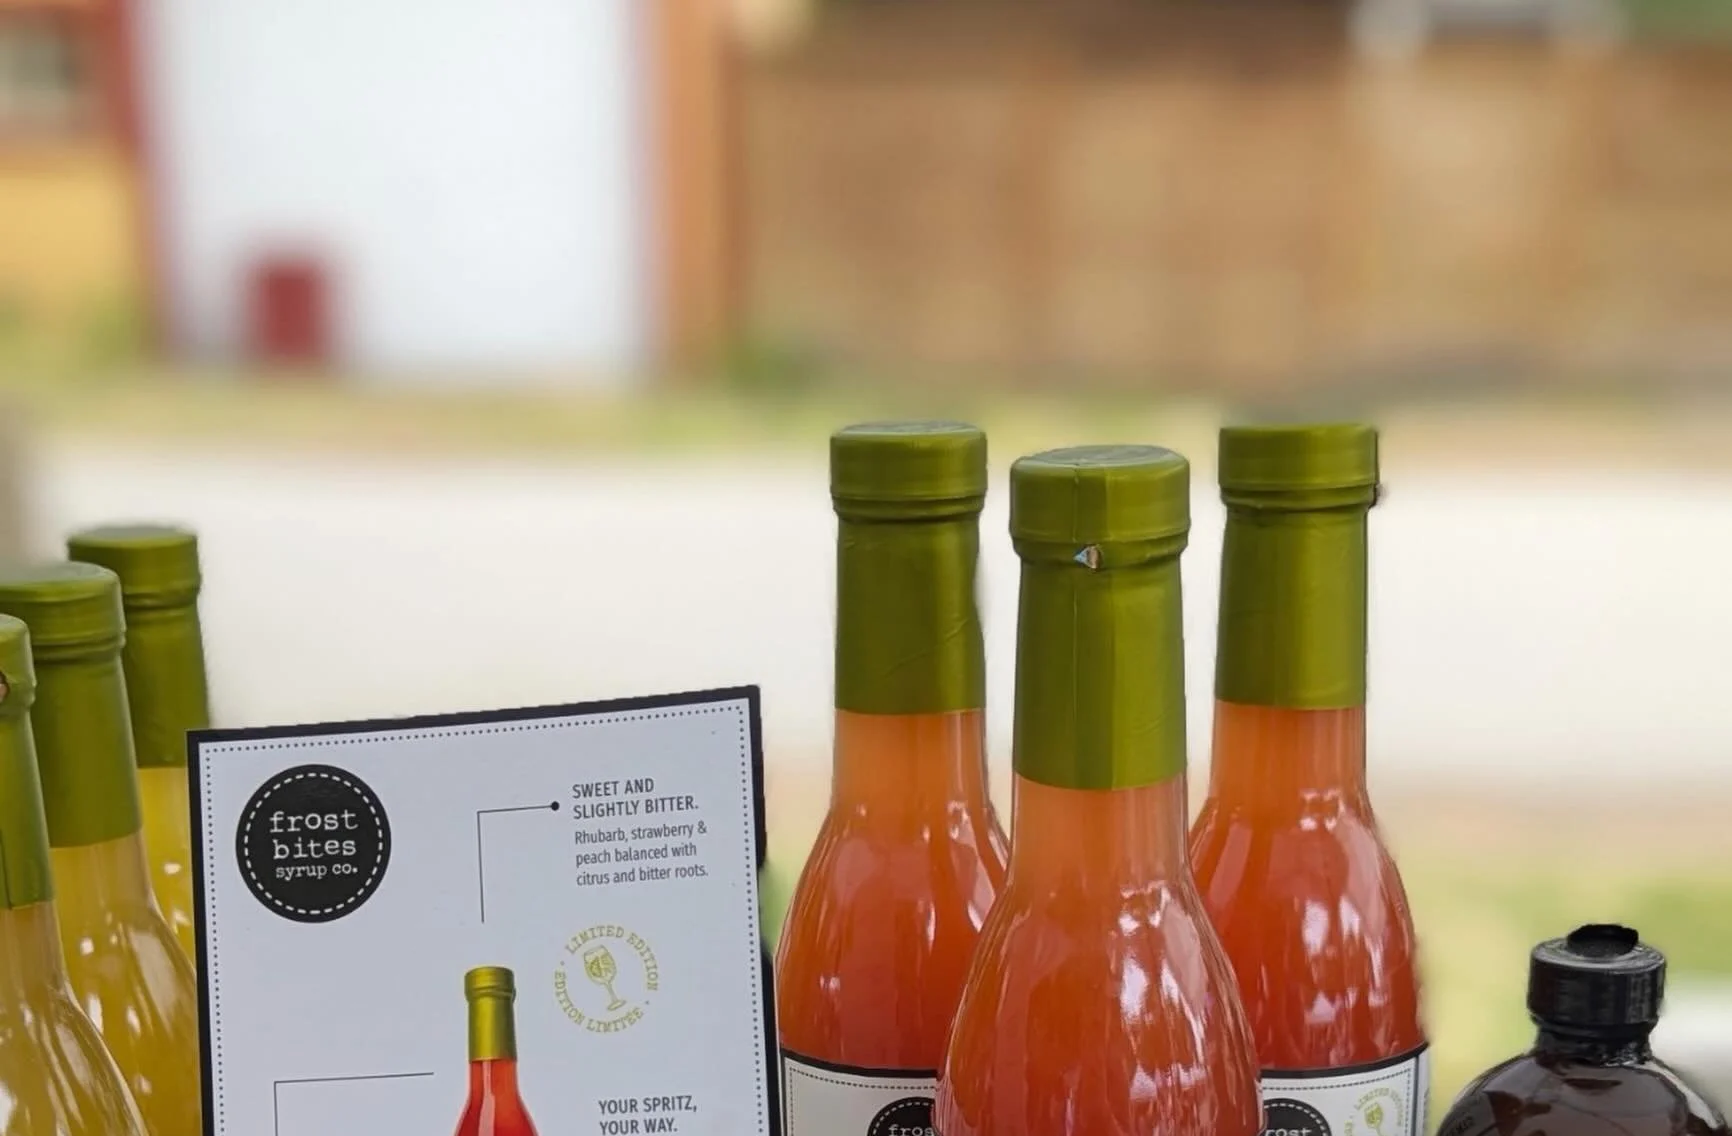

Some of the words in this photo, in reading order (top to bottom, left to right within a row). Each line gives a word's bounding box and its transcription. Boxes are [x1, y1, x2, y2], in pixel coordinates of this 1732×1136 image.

[572, 781, 620, 799] SWEET
[624, 778, 655, 795] AND
[573, 800, 640, 820] SLIGHTLY
[645, 795, 699, 814] BITTER.
[269, 809, 359, 833] frost
[575, 827, 628, 845] Rhubarb,
[631, 823, 694, 840] strawberry
[697, 820, 707, 834] &
[272, 836, 357, 860] bites
[576, 849, 611, 868] peach
[614, 844, 668, 862] balanced
[671, 843, 697, 858] with
[275, 865, 327, 881] syrup
[332, 863, 358, 875] co.
[576, 872, 610, 886] citrus
[613, 868, 635, 883] and
[639, 867, 671, 881] bitter
[675, 863, 709, 878] roots.
[565, 925, 625, 954] LIMITED
[627, 932, 659, 991] EDITION
[554, 970, 585, 1025] EDITION
[598, 1099, 639, 1115] YOUR
[643, 1095, 697, 1113] SPRITZ,
[600, 1120, 639, 1136] YOUR
[643, 1117, 678, 1134] WAY.
